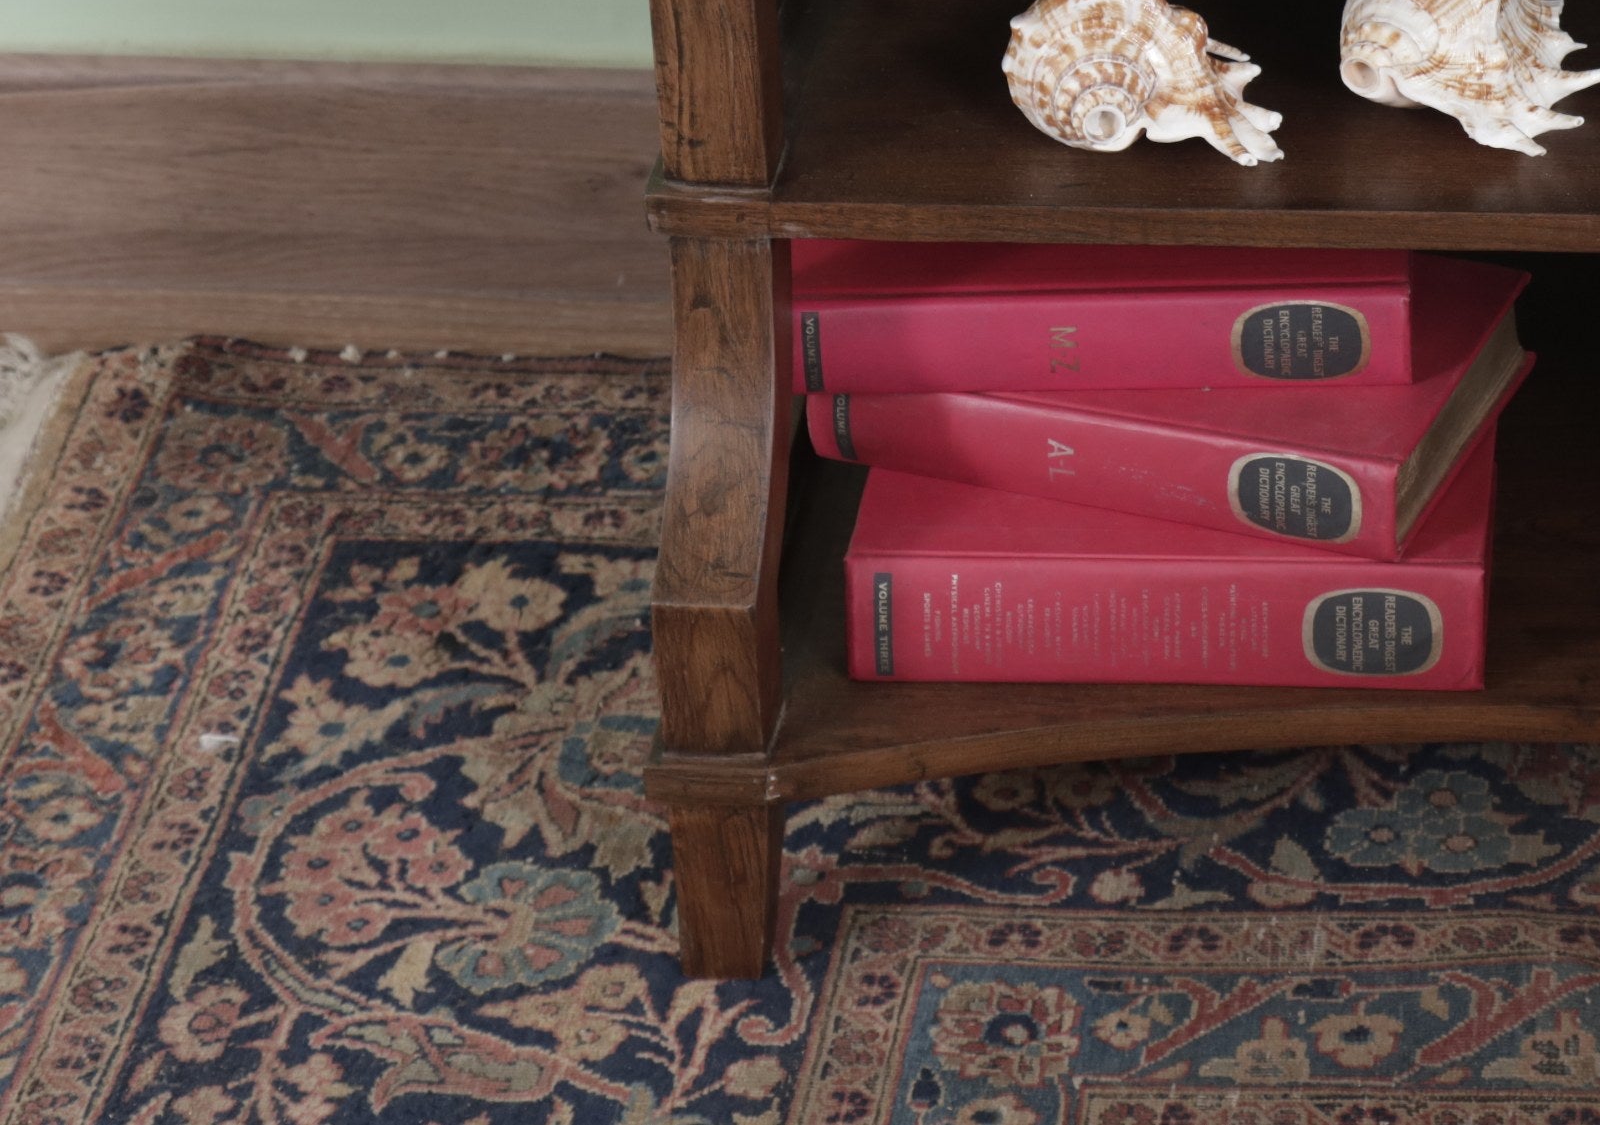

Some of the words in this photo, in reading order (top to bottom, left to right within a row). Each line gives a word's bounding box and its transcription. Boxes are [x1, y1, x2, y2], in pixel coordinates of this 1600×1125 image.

[805, 317, 817, 365] VOLUME
[1263, 319, 1274, 369] DICTIONARY
[1329, 335, 1339, 352] THE
[1259, 467, 1270, 522] DICTIONARY
[1275, 461, 1286, 531] ENCYCLOPAEDIC
[1290, 485, 1301, 515] GREAT
[1321, 497, 1331, 515] THE
[1306, 508, 1317, 538] DIGEST
[878, 582, 888, 631] VOLUME
[1336, 605, 1347, 662] DICTIONARY
[1352, 596, 1363, 671] ENCYCLOPAEDIC
[1368, 619, 1379, 650] GREAT
[1401, 626, 1412, 645] THE
[1385, 640, 1396, 672] DIGEST
